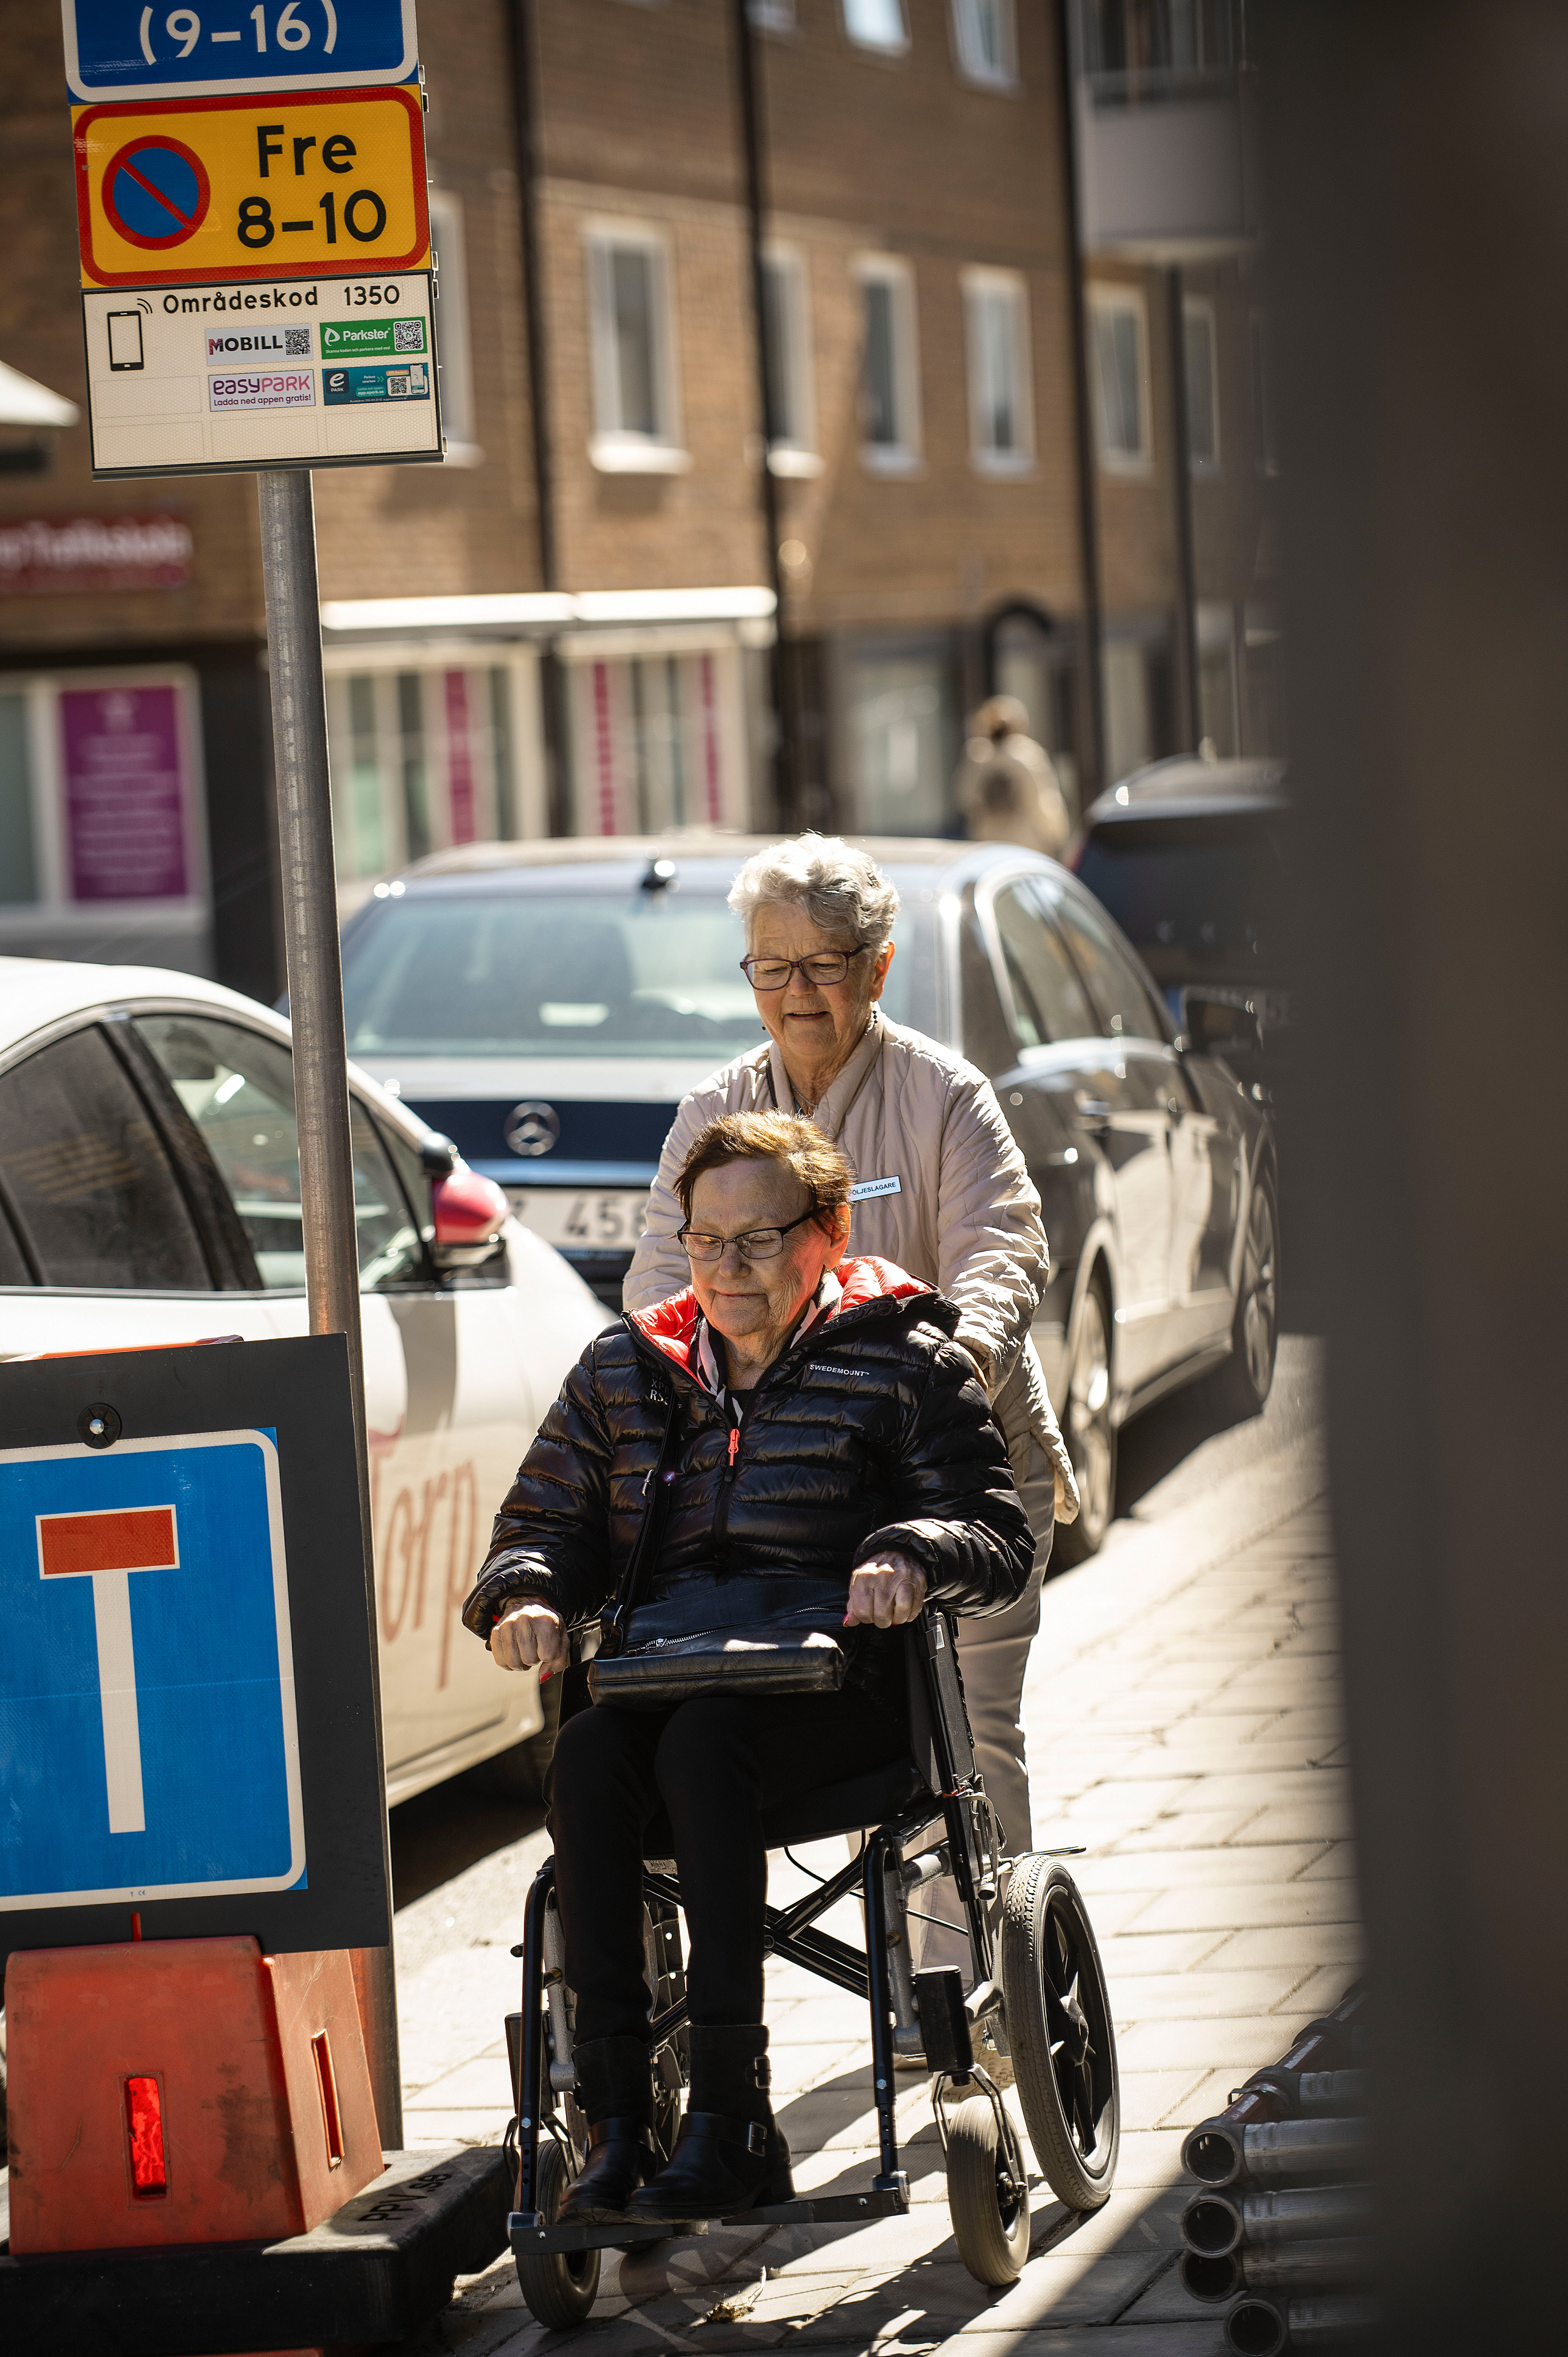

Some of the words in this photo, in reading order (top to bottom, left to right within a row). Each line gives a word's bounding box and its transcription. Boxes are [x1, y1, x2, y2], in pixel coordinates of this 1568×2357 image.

[256, 124, 357, 178] Fre
[237, 189, 387, 249] 8-10
[163, 286, 318, 313] Områdeskod
[344, 284, 400, 306] 1350
[208, 335, 283, 355] MOBILL
[343, 329, 389, 341] Parkster
[258, 396, 284, 405] appen
[286, 394, 311, 404] gratis!
[851, 1182, 896, 1196] ÖLJESLAGARE
[357, 2173, 452, 2222] PPV.se
